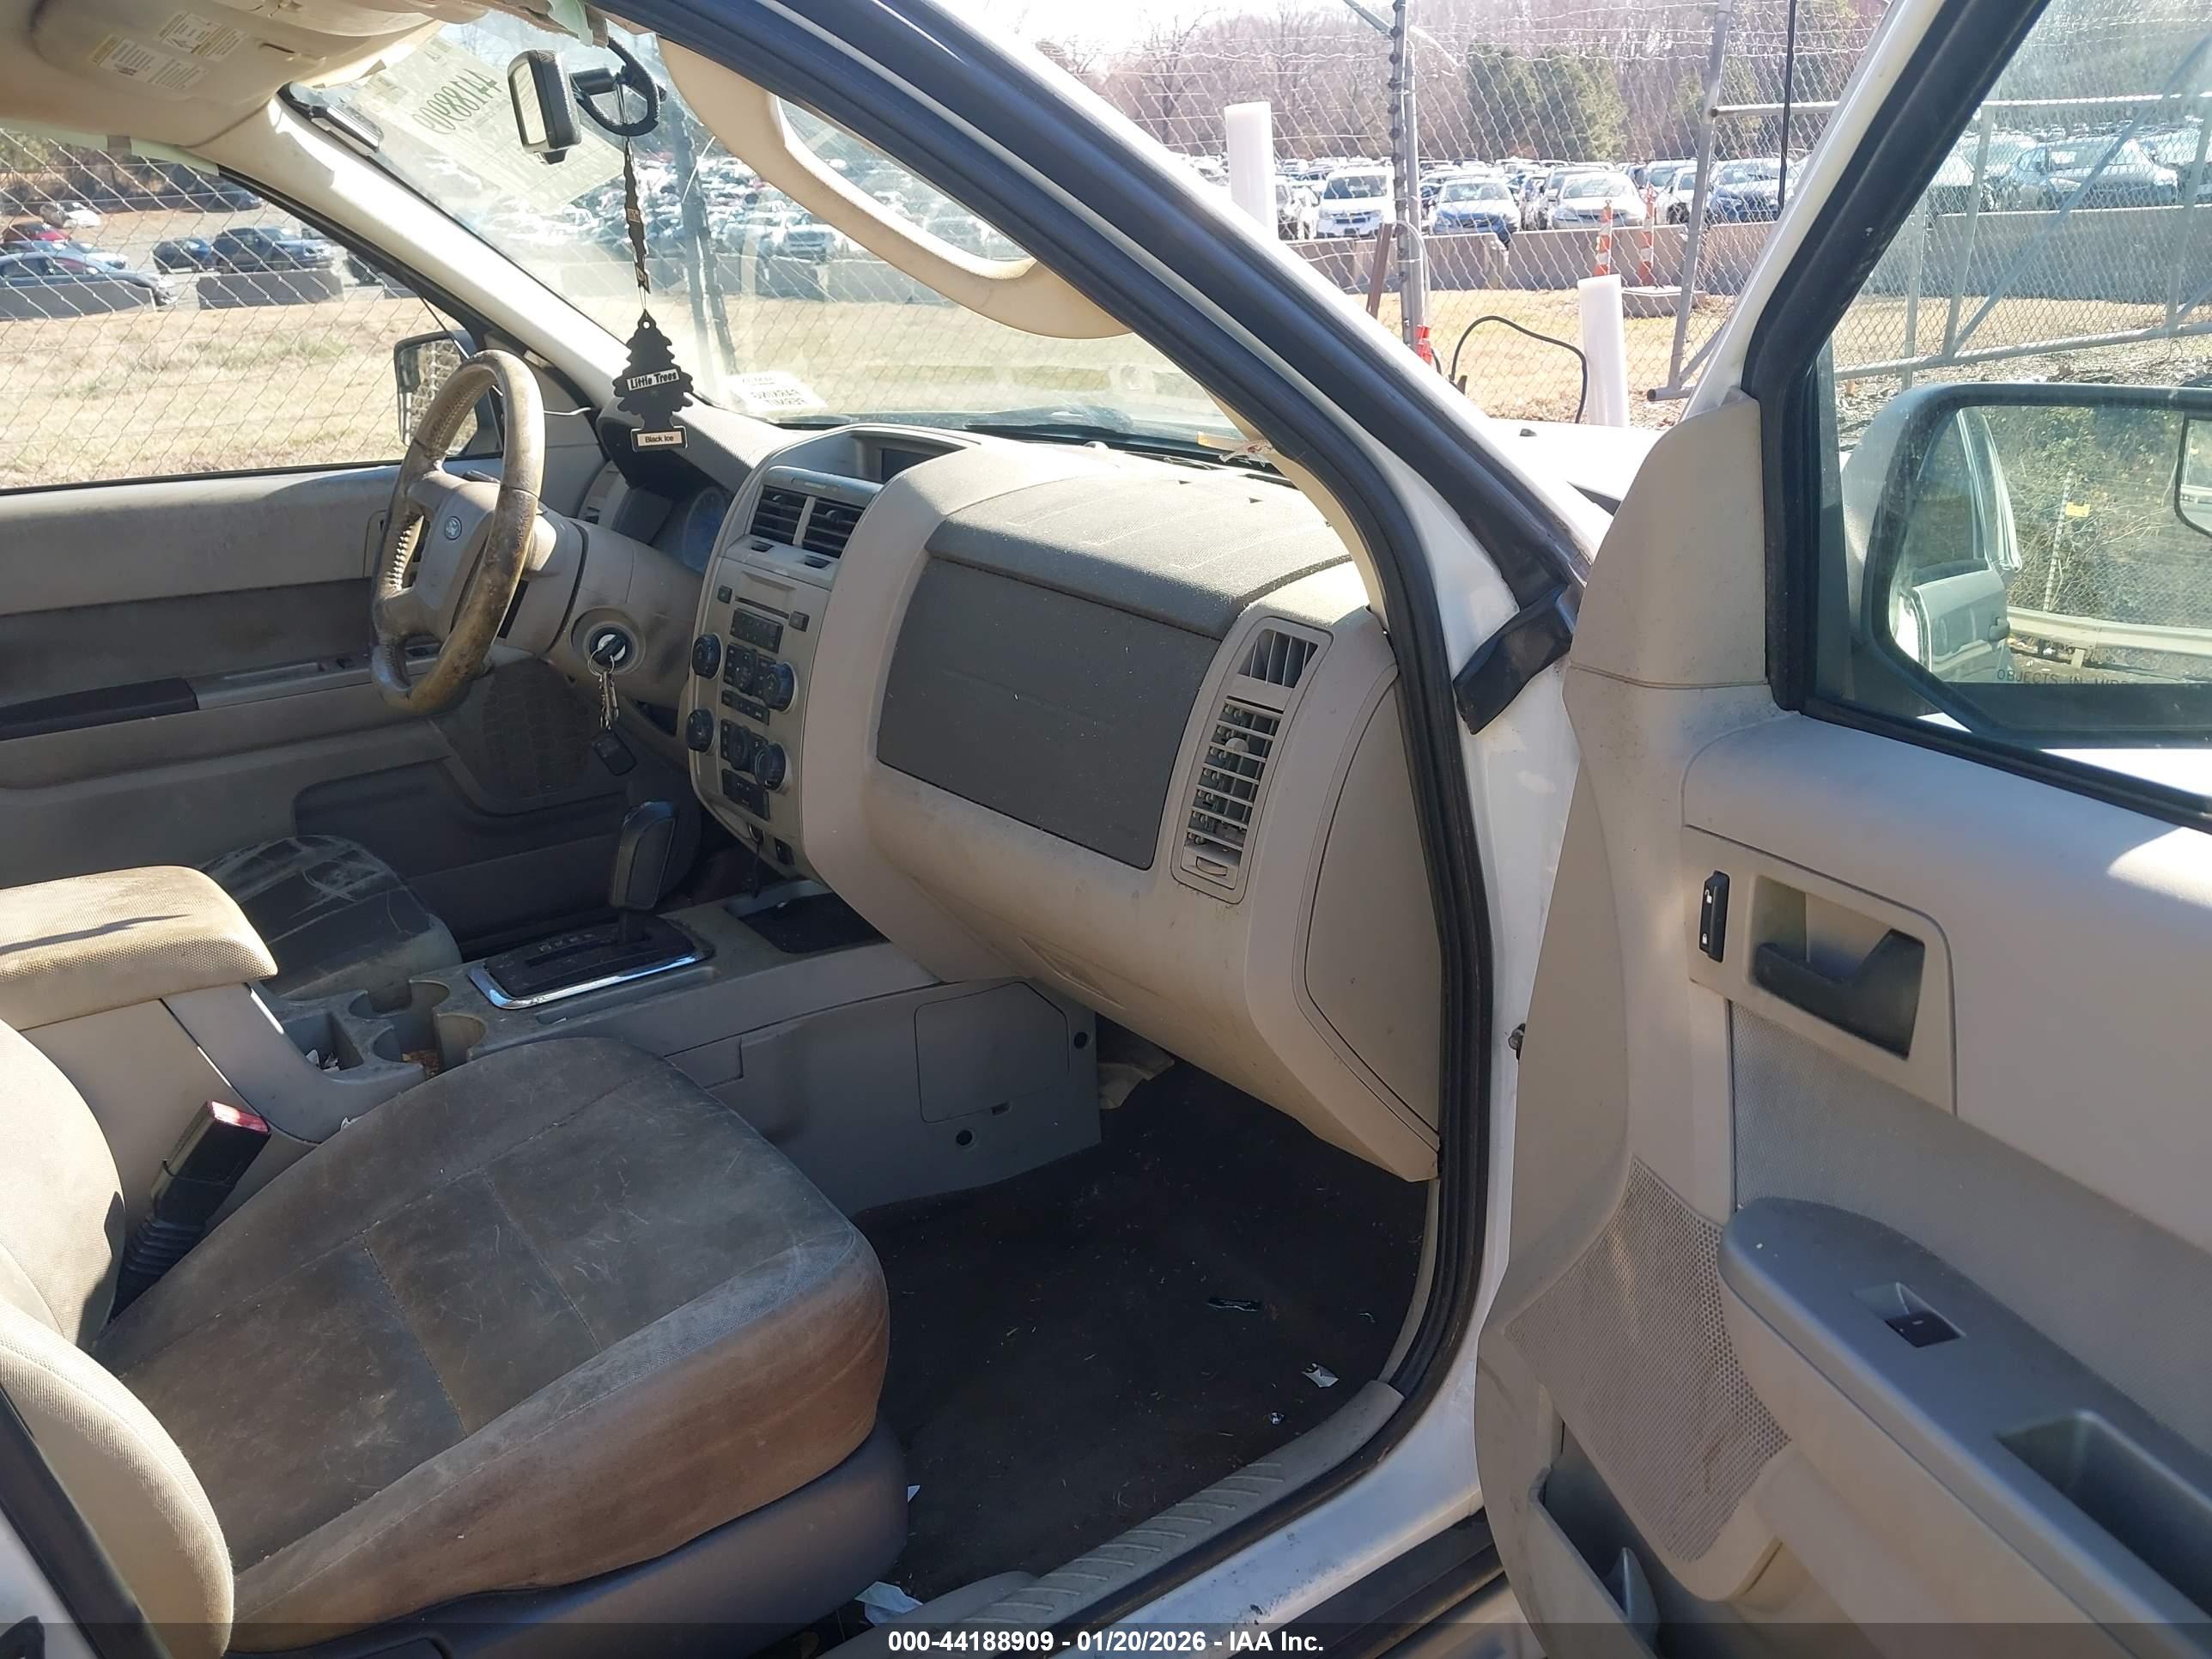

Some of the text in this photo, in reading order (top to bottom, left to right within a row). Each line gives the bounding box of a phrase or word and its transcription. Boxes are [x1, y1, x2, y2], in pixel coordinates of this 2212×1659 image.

[630, 372, 677, 389] Little Trees
[1996, 668, 2059, 685] OBJECTS
